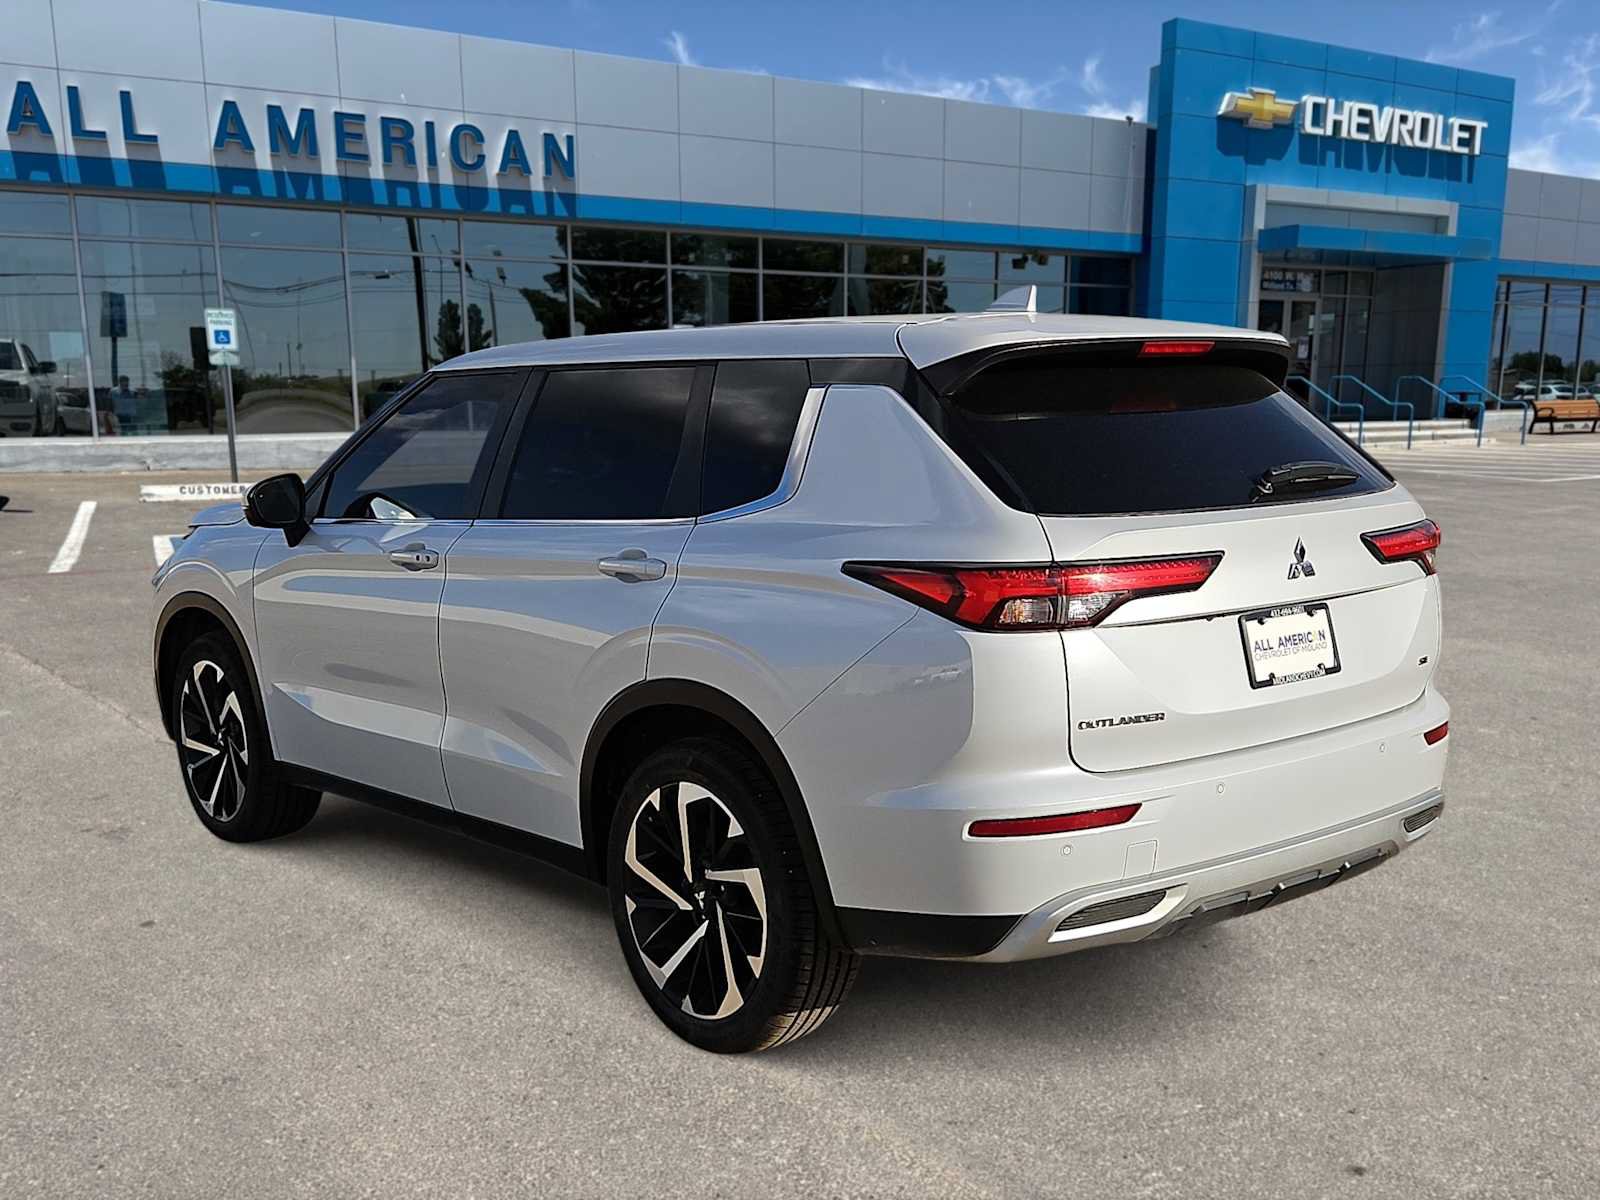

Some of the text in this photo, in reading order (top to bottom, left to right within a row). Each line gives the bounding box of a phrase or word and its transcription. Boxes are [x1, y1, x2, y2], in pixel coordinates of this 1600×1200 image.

[7, 80, 576, 178] ALL AMERICAN
[1302, 94, 1488, 155] CHEVROLET
[179, 485, 247, 495] CUSTOMER
[1254, 639, 1273, 653] ALL
[1254, 648, 1291, 661] CHEVROLET
[1078, 712, 1165, 730] OUTLANDER
